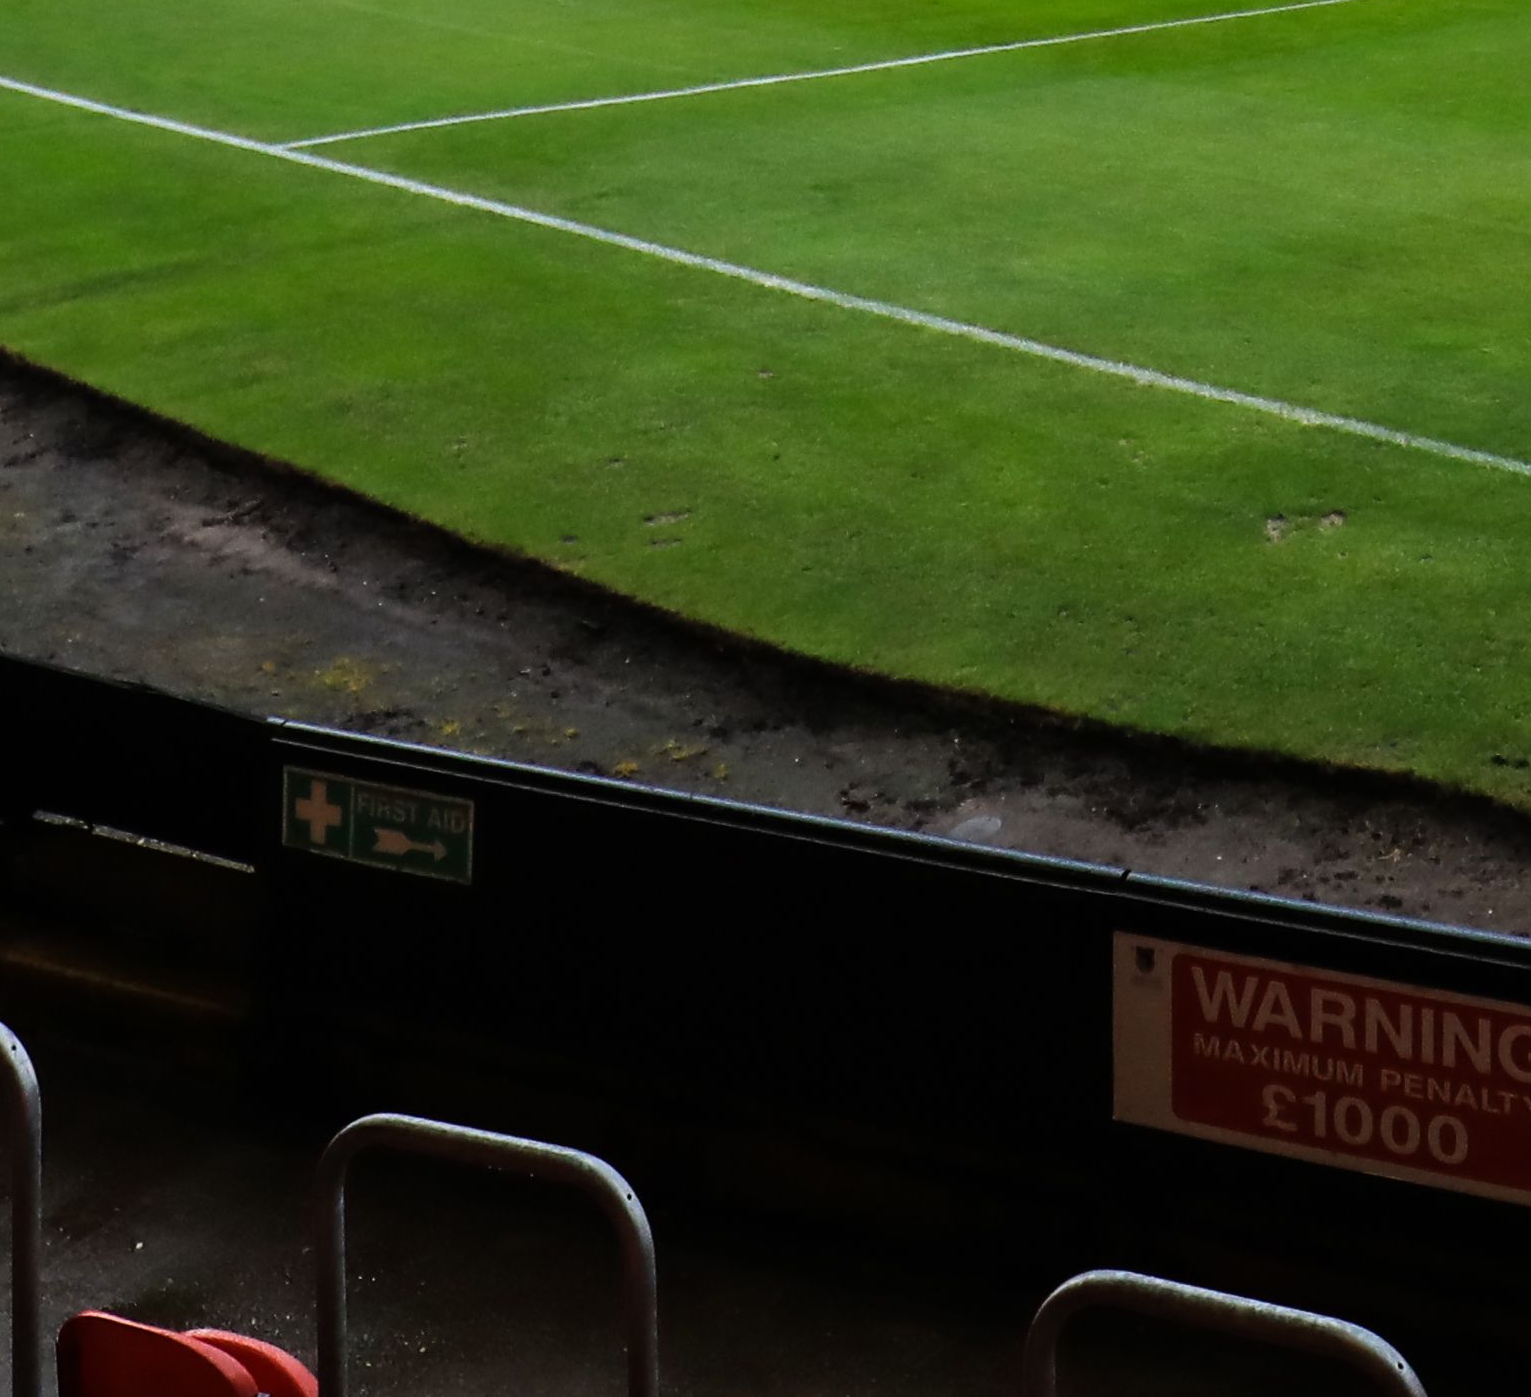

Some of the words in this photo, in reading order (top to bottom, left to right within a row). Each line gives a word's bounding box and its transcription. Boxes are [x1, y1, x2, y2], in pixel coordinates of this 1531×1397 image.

[356, 792, 419, 824] FIRST
[427, 807, 467, 835] AID
[1193, 1032, 1364, 1087] MAXIMUM
[1261, 1083, 1469, 1165] £1000
